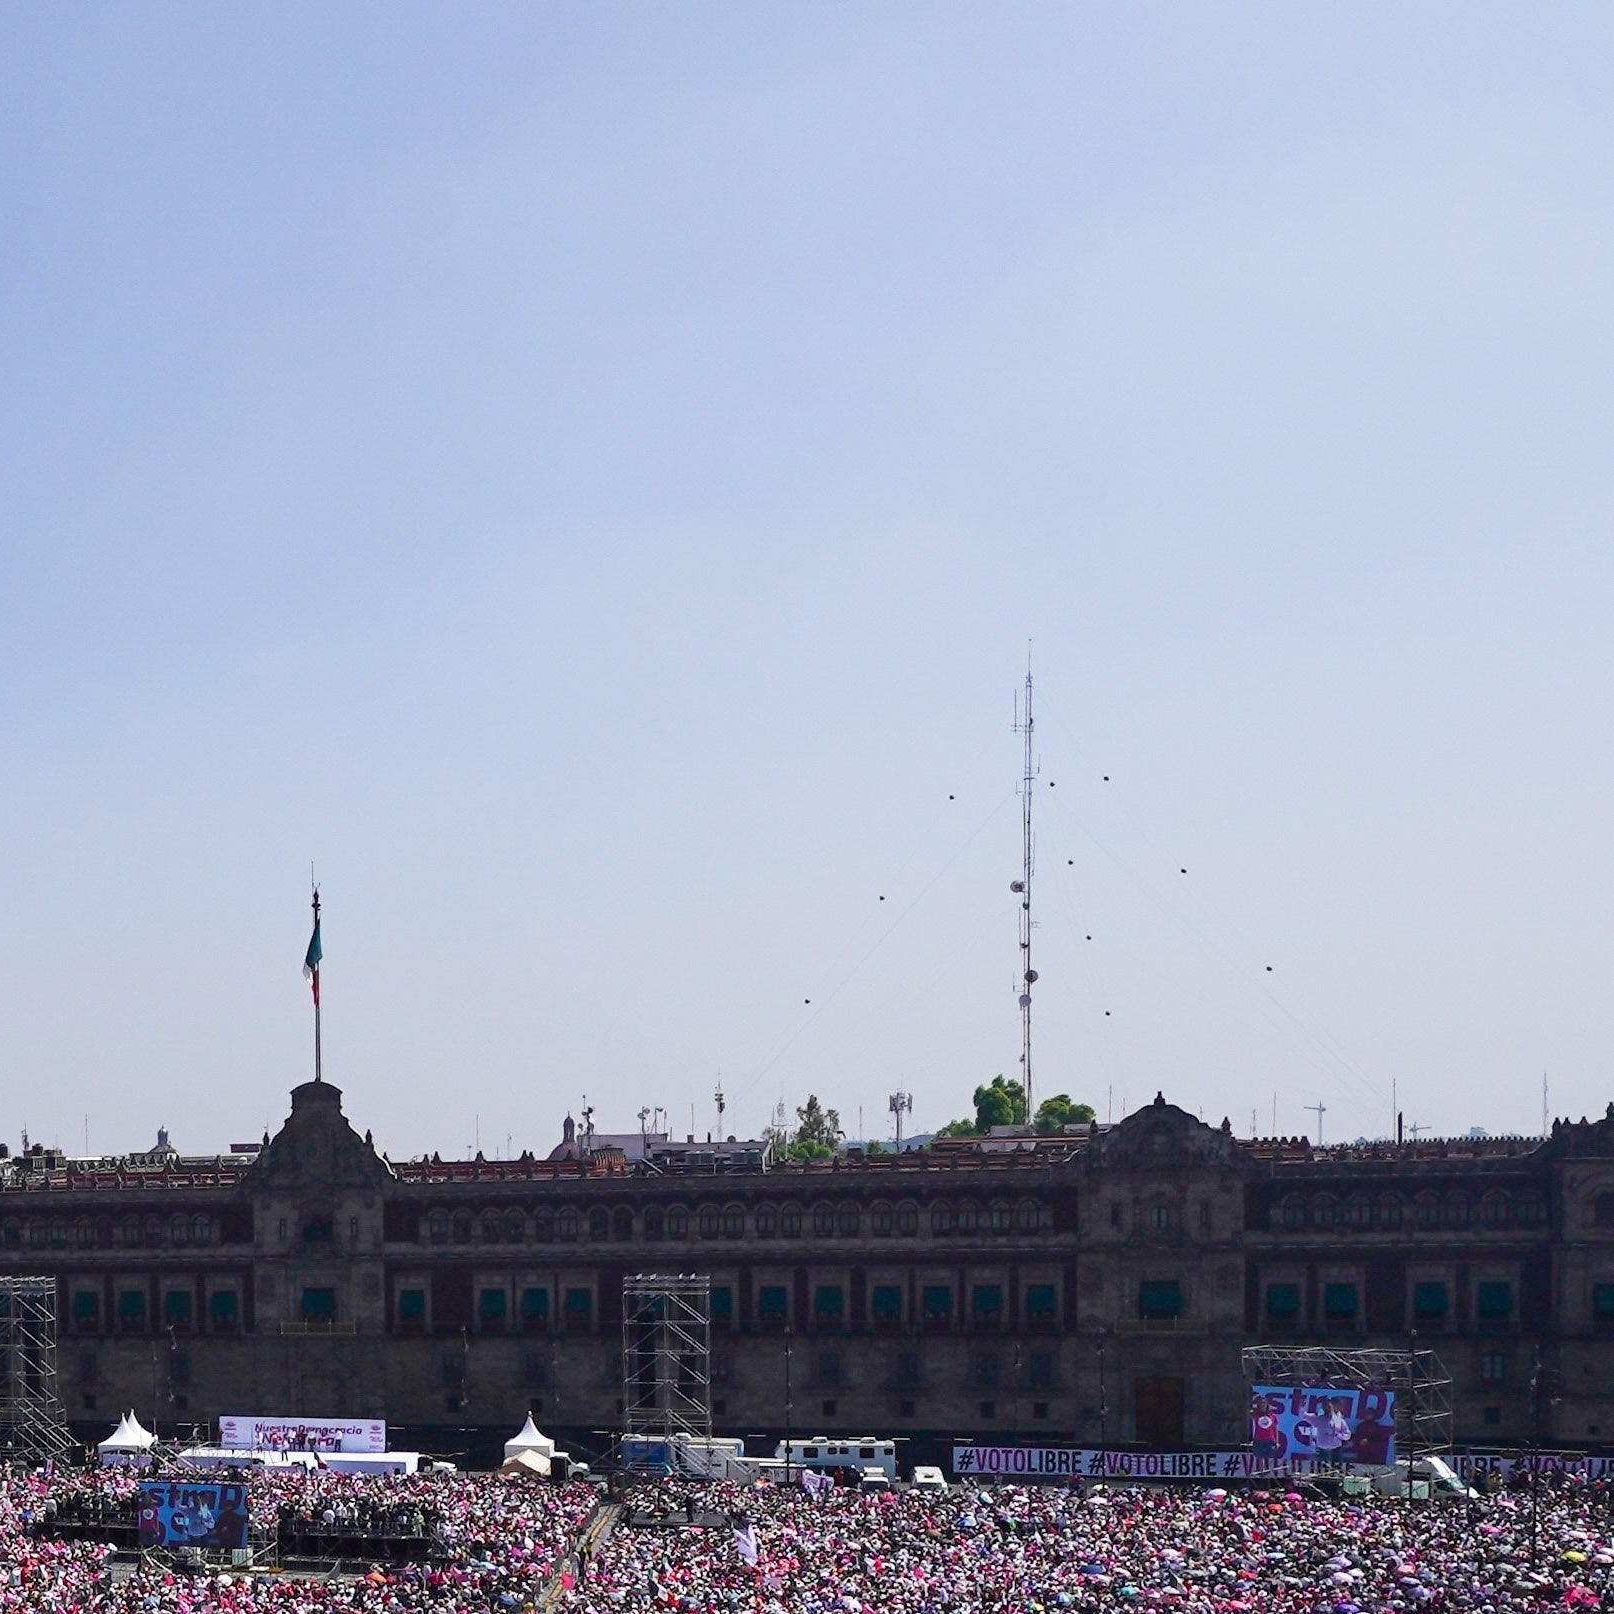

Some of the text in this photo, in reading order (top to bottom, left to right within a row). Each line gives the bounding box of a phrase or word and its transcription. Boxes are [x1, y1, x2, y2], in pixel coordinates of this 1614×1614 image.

[1252, 1389, 1395, 1420] straD
[958, 1448, 1082, 1473] #VOTOLIBRE
[1088, 1451, 1216, 1477] #VOTOLIBRE
[139, 1485, 248, 1511] straD
